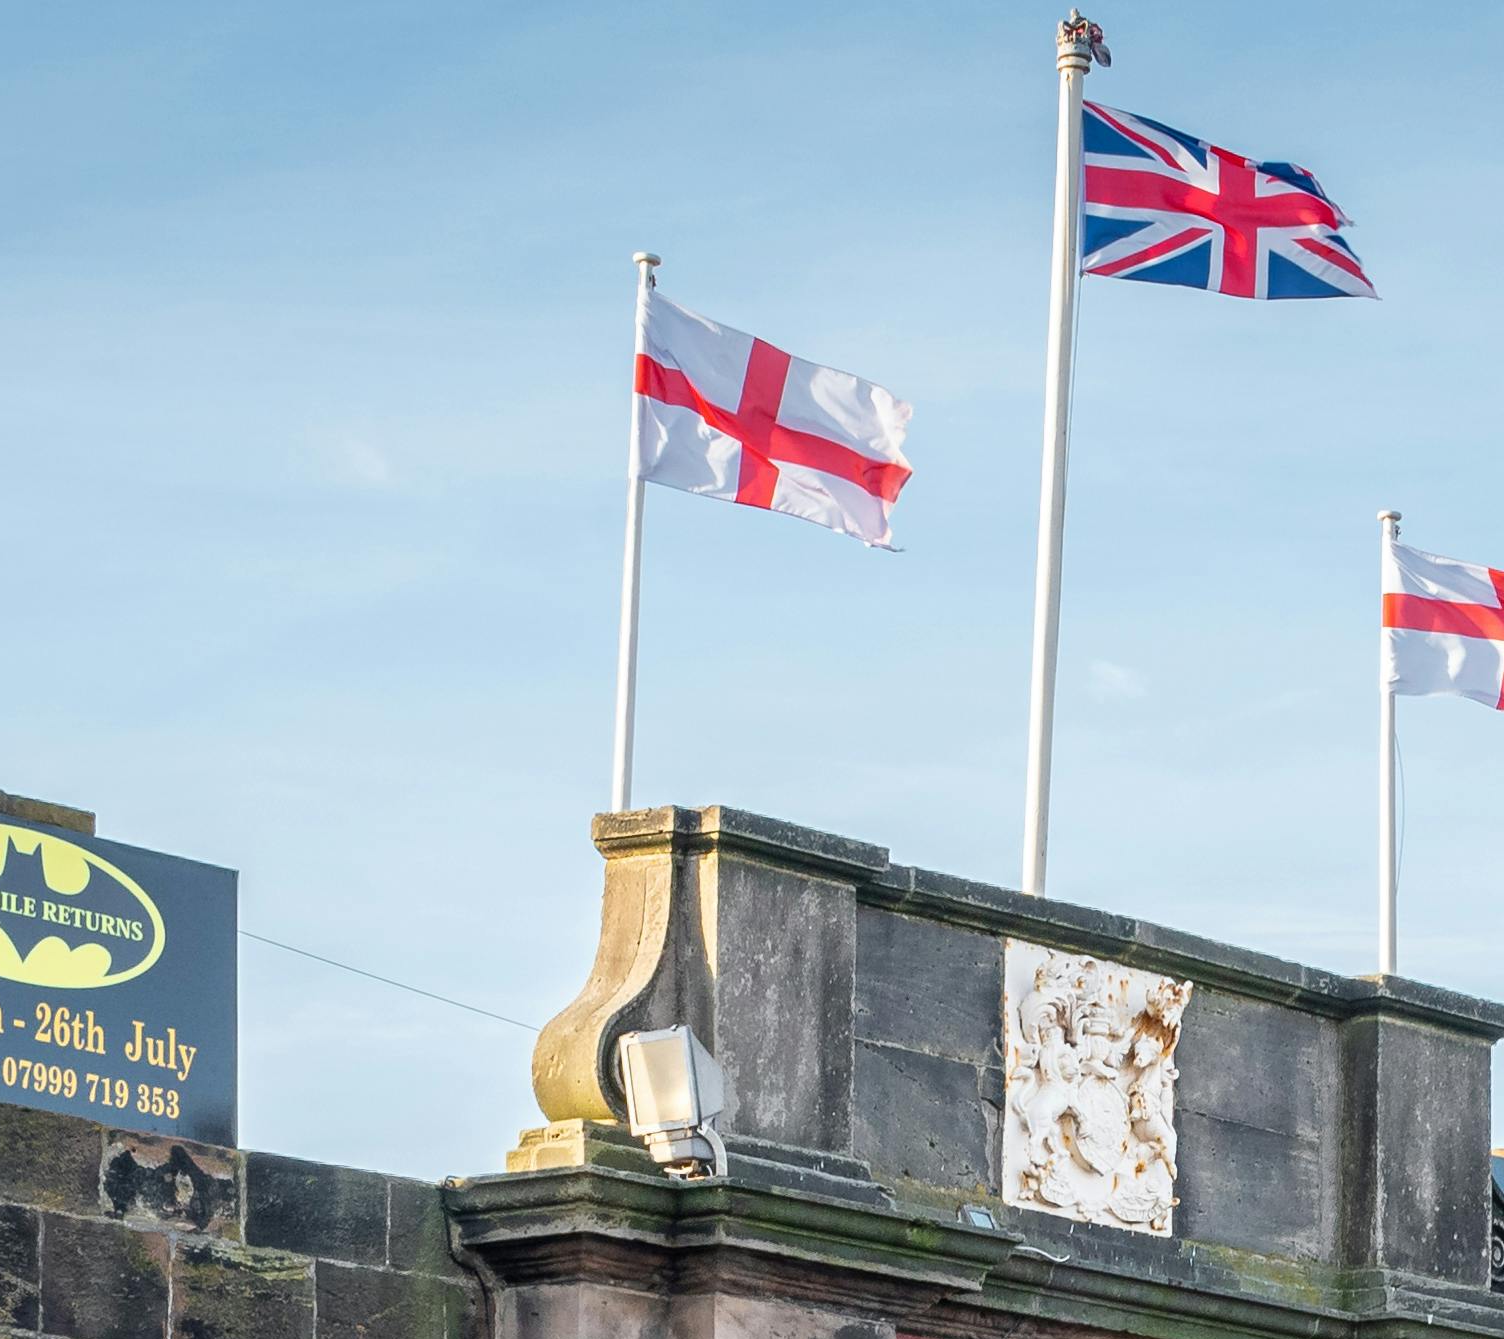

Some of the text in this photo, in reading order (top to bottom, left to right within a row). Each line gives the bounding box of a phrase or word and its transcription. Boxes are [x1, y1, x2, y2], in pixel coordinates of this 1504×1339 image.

[42, 902, 144, 942] RETURNS
[13, 1018, 25, 1030] -
[35, 1002, 106, 1055] 26th
[124, 1020, 197, 1081] July
[2, 1056, 78, 1099] 07999
[86, 1074, 129, 1109] 719
[136, 1087, 180, 1120] 353
